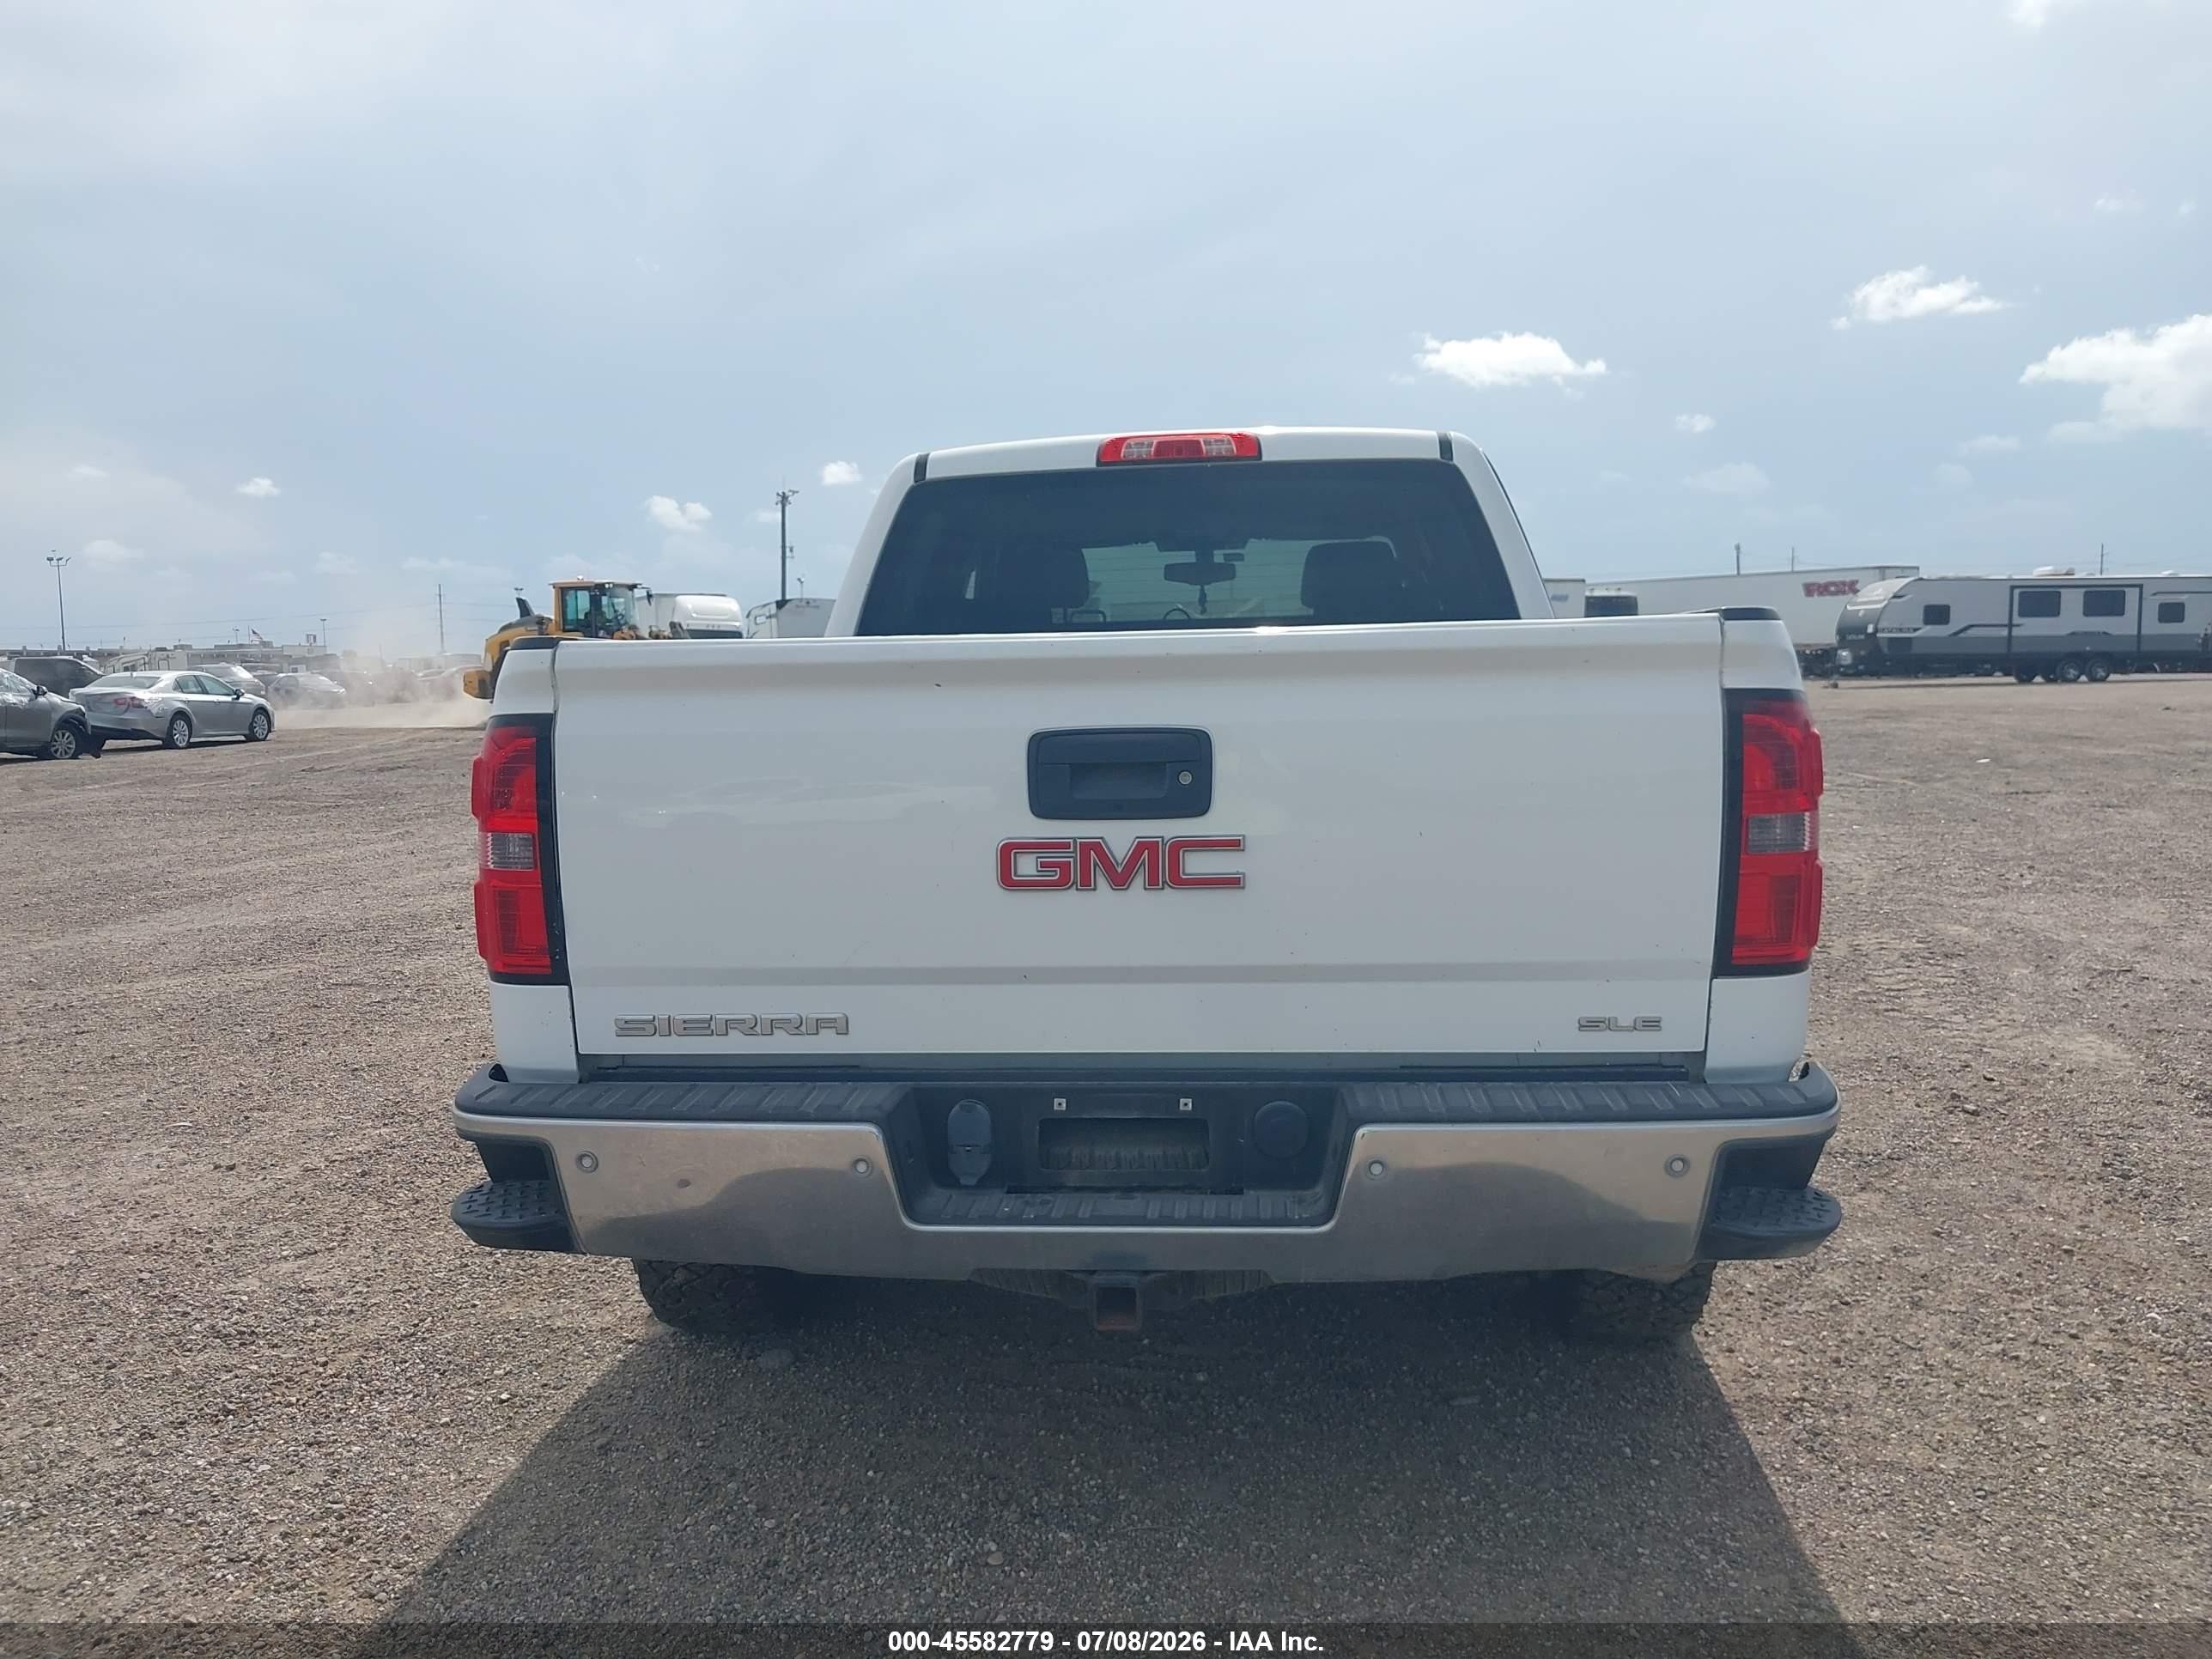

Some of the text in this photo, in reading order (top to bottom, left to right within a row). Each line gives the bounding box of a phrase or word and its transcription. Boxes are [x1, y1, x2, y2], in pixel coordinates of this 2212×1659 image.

[996, 835, 1246, 890] GMC
[614, 1012, 849, 1037] SIERRA
[1578, 1016, 1662, 1032] SLE
